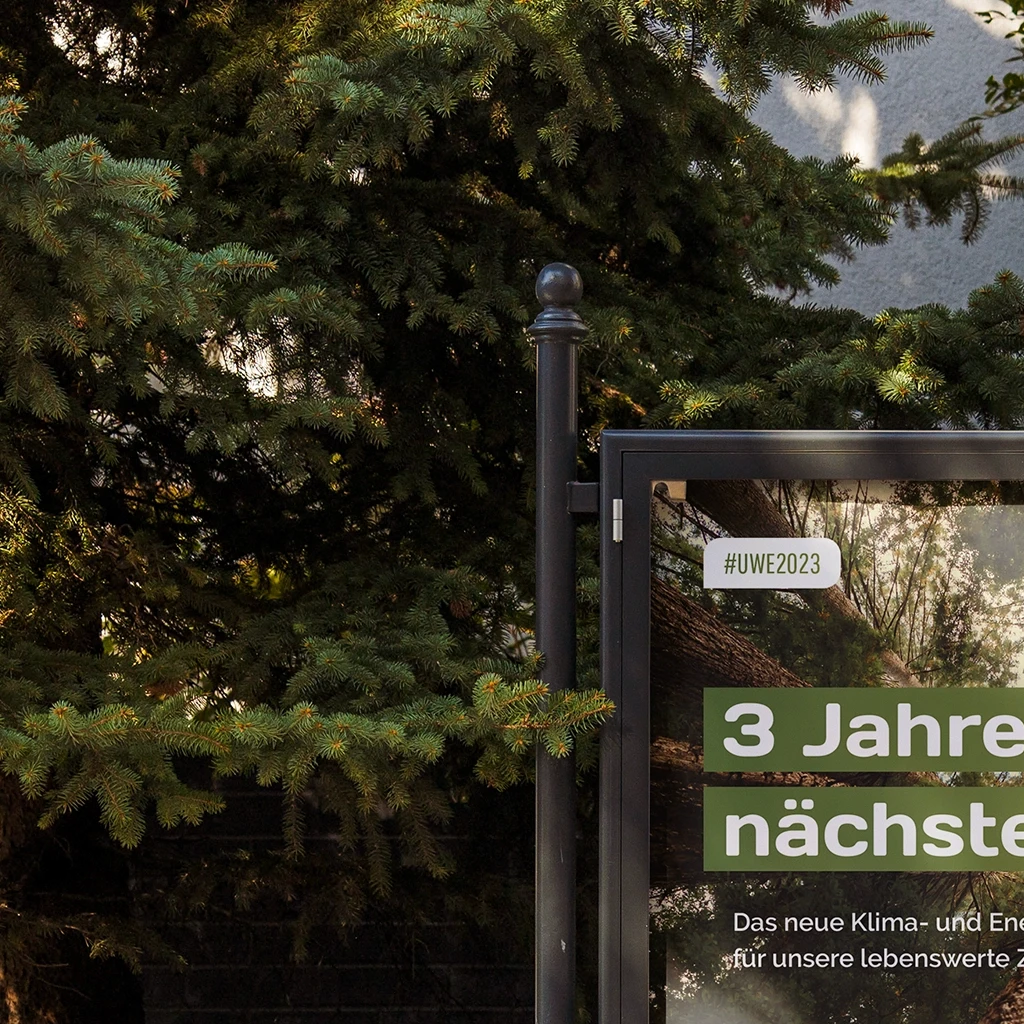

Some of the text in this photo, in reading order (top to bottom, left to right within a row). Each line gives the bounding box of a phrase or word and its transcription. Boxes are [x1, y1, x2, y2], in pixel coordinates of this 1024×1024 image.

[724, 553, 821, 575] #UWE2023
[723, 703, 774, 758] 3
[733, 913, 777, 932] Das
[784, 917, 844, 932] neue
[851, 911, 928, 932] Klima-
[936, 911, 981, 932] und
[733, 948, 766, 968] für
[772, 952, 854, 968] unsere
[861, 947, 1010, 968] lebenswerte
